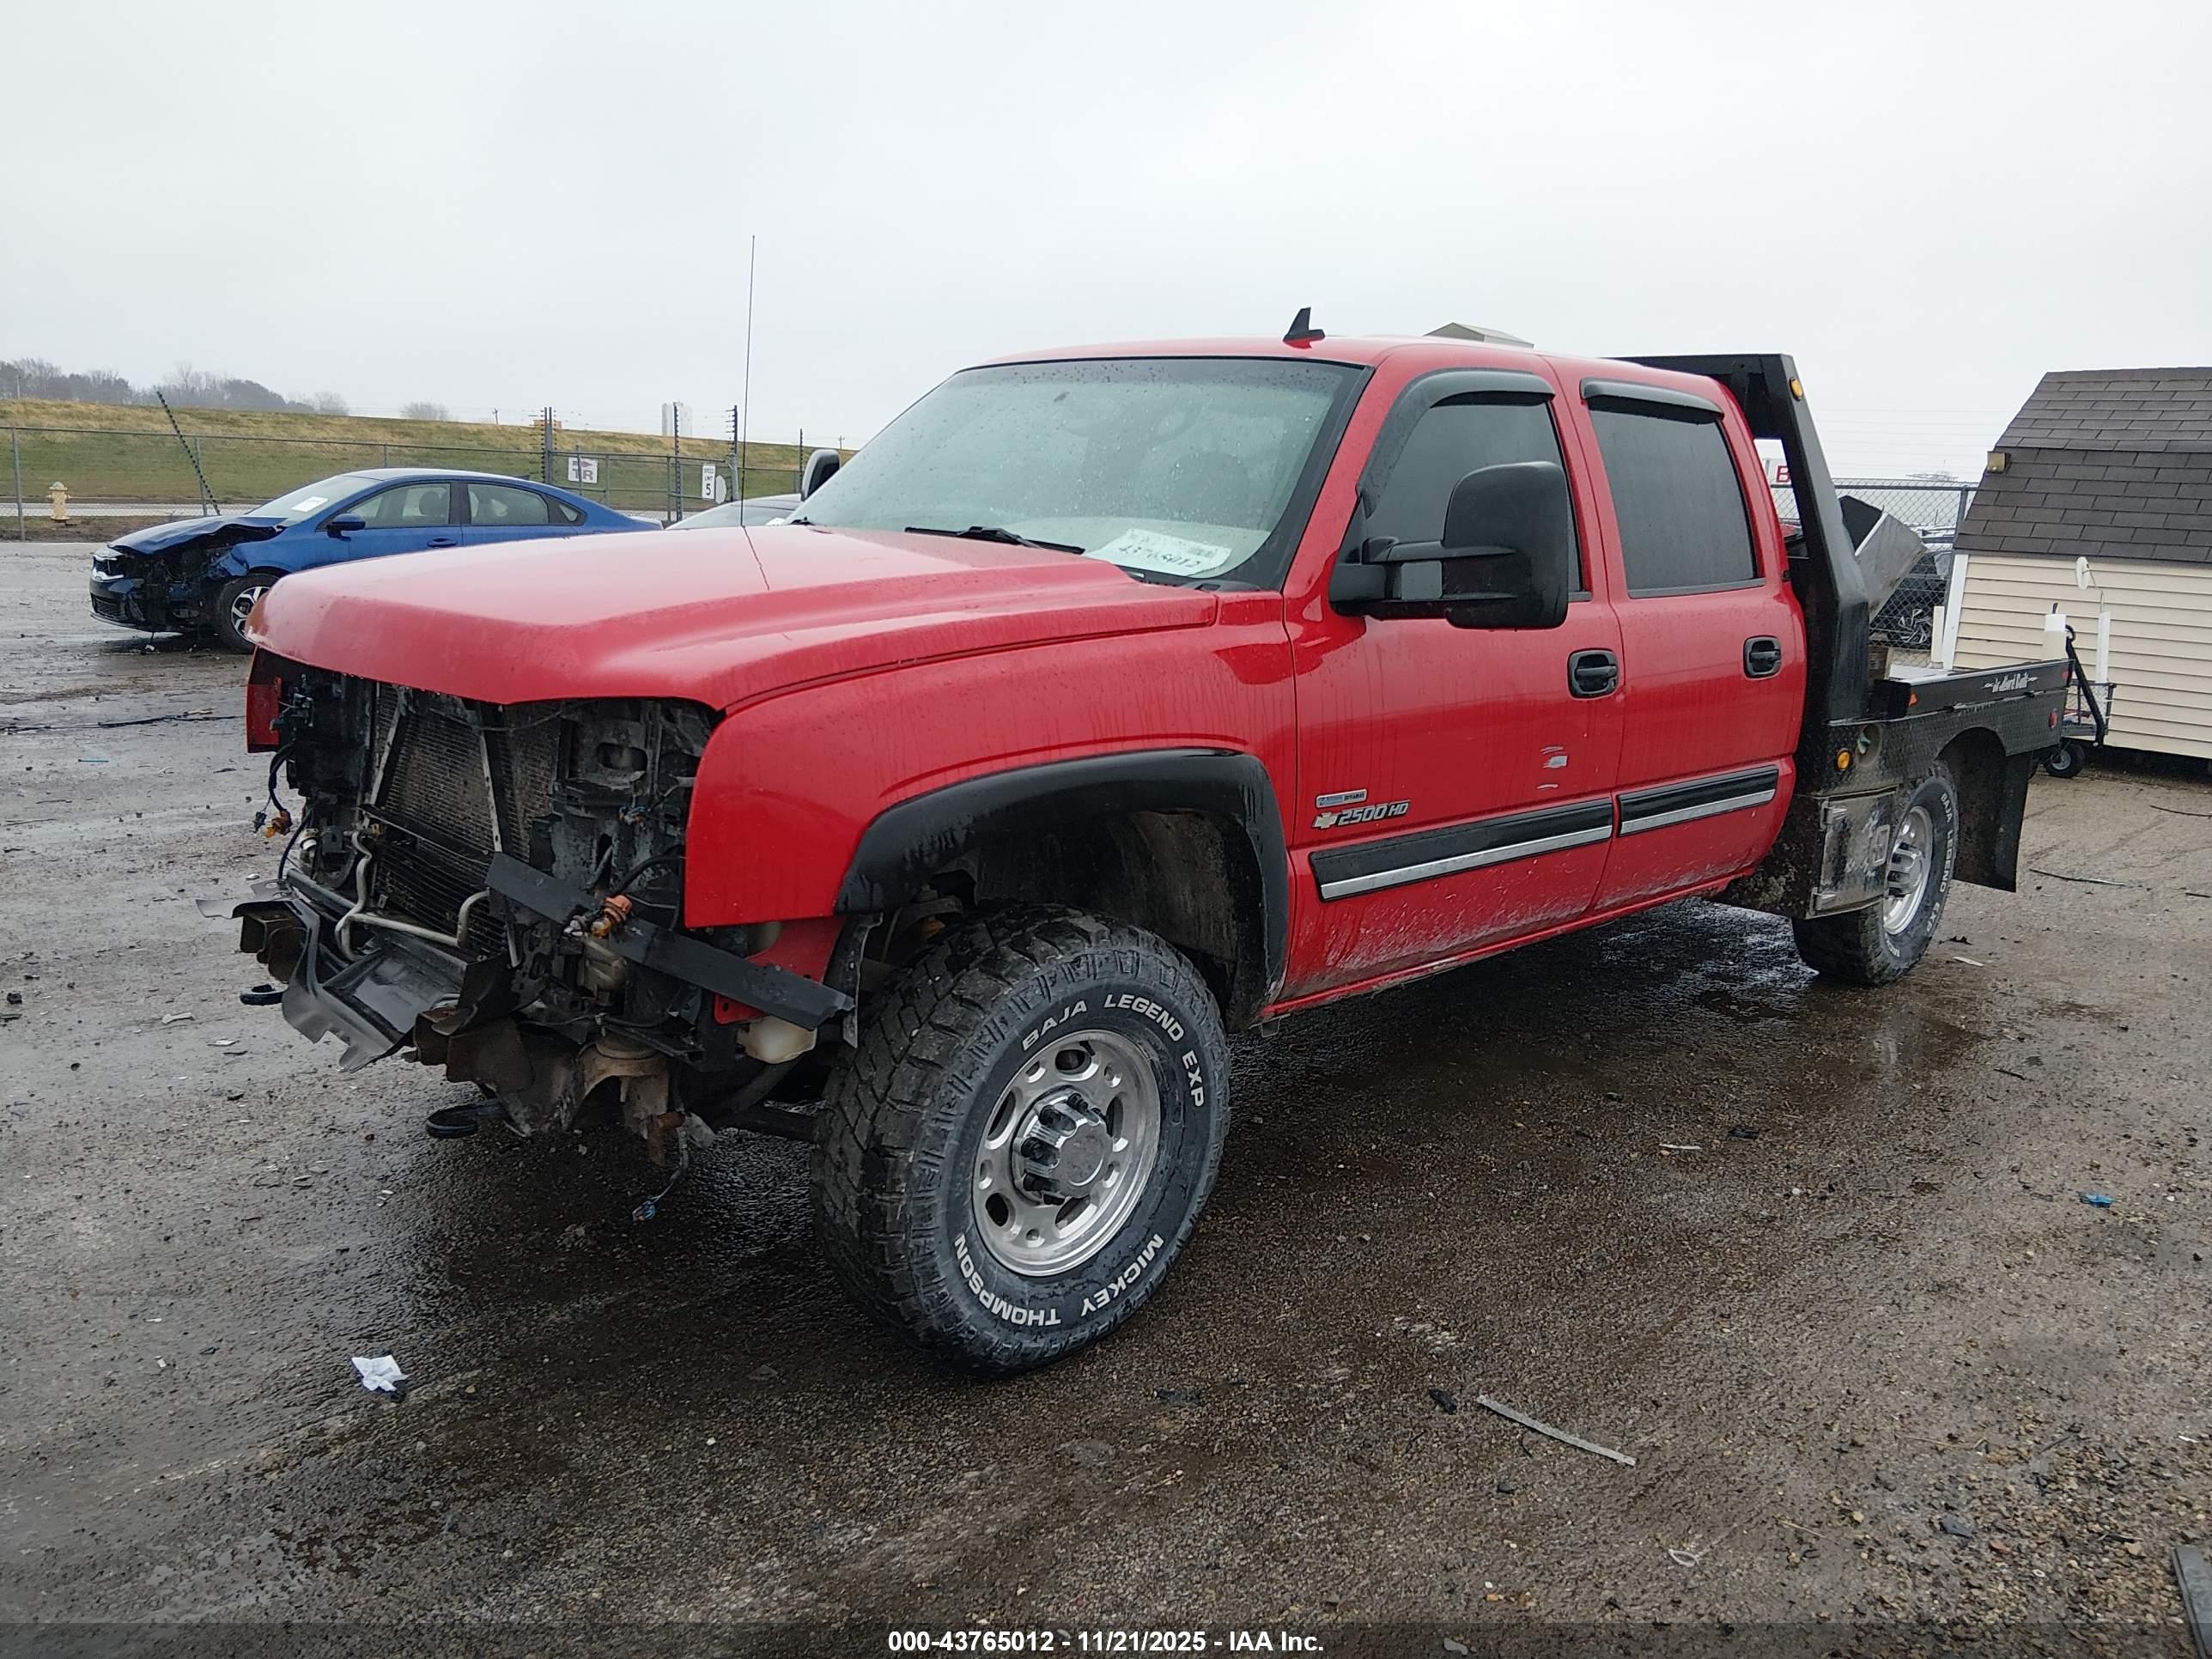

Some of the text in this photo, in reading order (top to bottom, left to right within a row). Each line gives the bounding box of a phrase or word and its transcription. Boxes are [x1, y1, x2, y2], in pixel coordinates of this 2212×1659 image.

[706, 483, 712, 495] 5
[1337, 801, 1409, 826] 2500 HD
[1940, 793, 1953, 823] BAJA
[1939, 830, 1954, 893] LEGEND
[1022, 994, 1205, 1108] BAJA LEGEND EXP
[954, 1234, 1164, 1327] MICKEY THOMPSON
